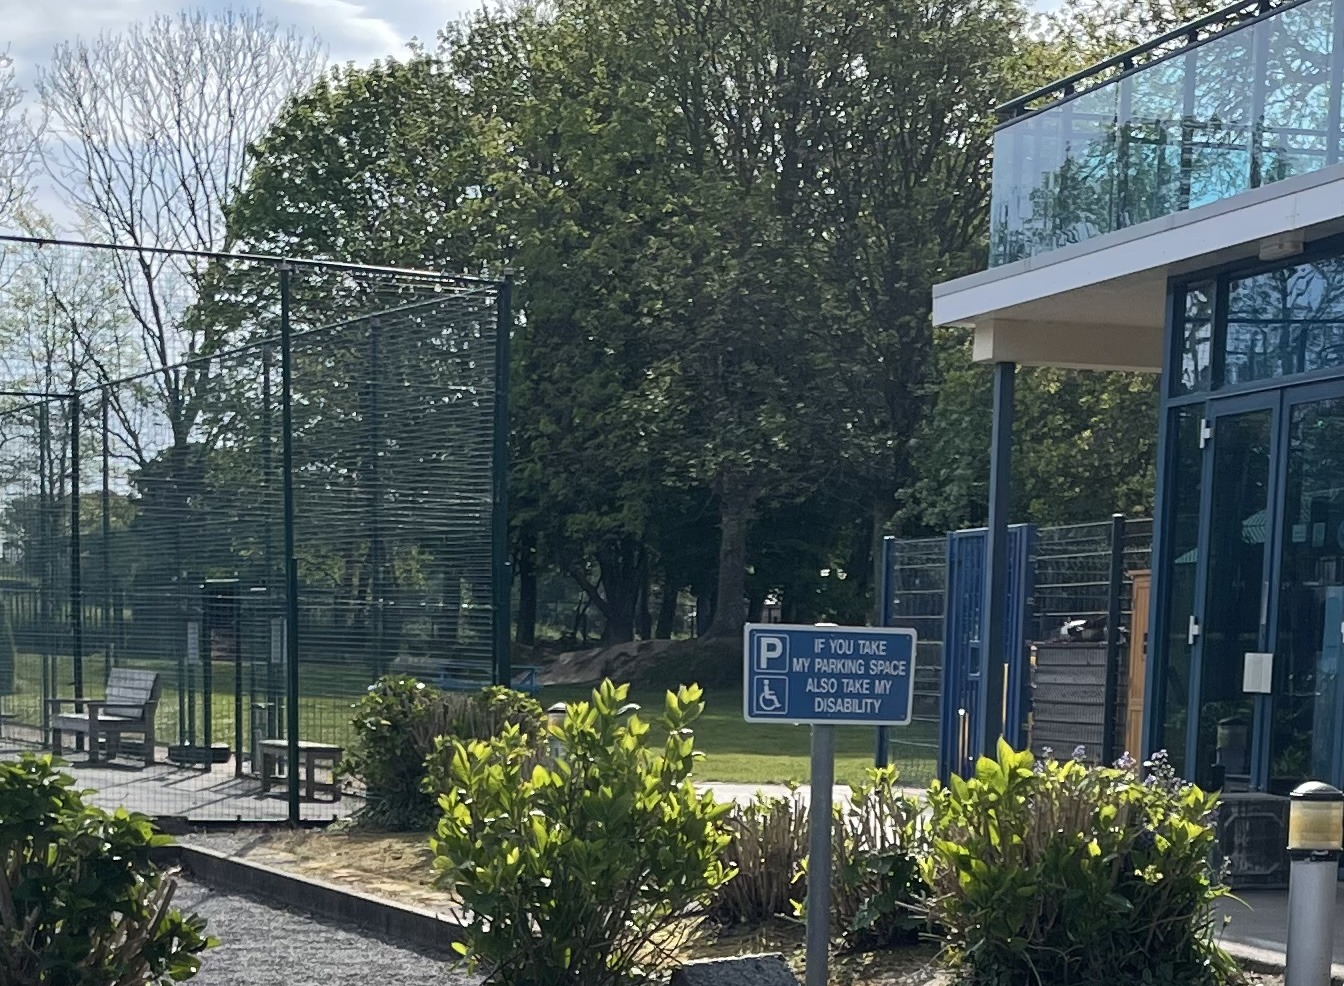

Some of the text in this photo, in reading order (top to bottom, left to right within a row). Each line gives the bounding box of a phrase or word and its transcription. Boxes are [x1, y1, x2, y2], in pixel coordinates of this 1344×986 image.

[760, 637, 783, 669] P
[814, 638, 887, 656] IF YOU TAKE
[792, 657, 907, 676] MY PARKING SPACE
[806, 678, 893, 695] ALSO TAKE MY
[814, 697, 882, 714] DISABILITY
